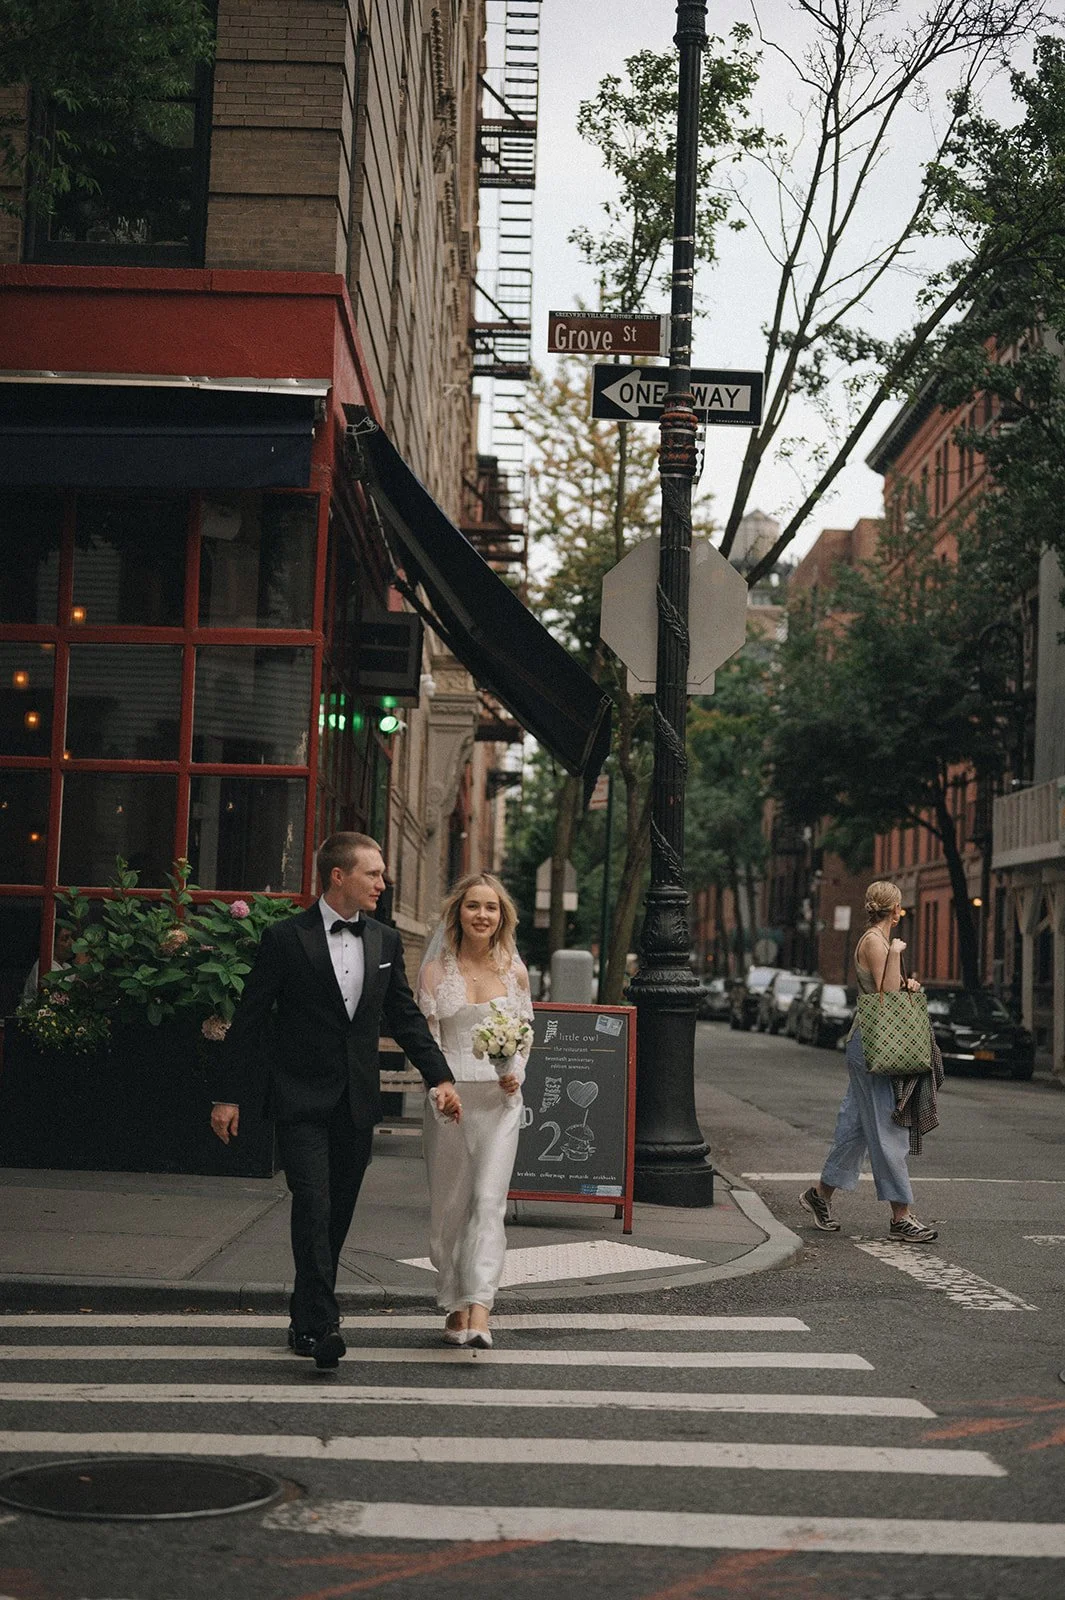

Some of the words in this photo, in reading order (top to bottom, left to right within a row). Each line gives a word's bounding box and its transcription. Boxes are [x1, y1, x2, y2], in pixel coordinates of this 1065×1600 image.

[555, 323, 613, 350] Grove
[623, 325, 637, 342] St
[619, 383, 666, 404] ONE
[690, 386, 741, 408] WAY
[559, 1033, 580, 1042] little
[582, 1034, 599, 1042] owl
